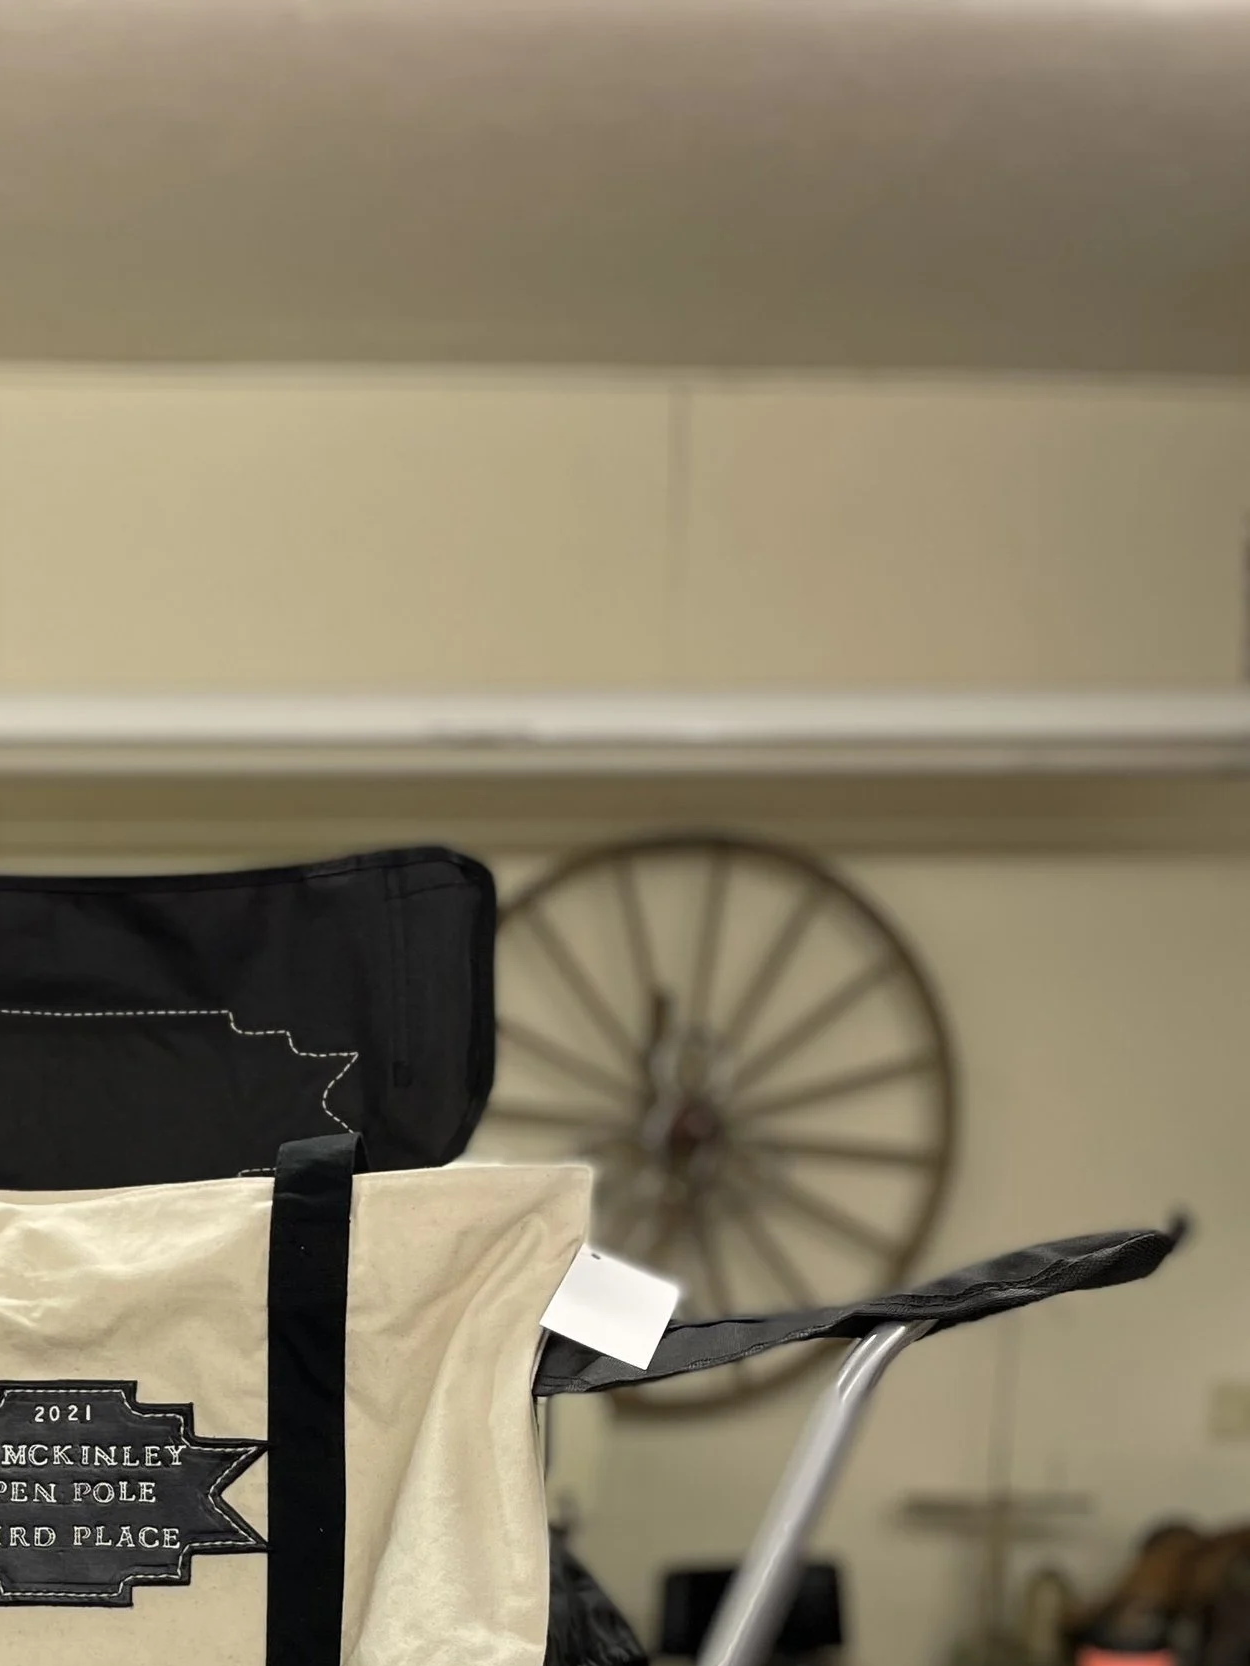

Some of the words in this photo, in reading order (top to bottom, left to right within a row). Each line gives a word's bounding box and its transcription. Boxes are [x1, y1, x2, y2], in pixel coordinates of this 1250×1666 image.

[34, 1404, 91, 1423] 2021
[1, 1444, 187, 1466] MCKINLEY
[72, 1480, 157, 1503] POLE
[73, 1525, 181, 1549] PLACE
